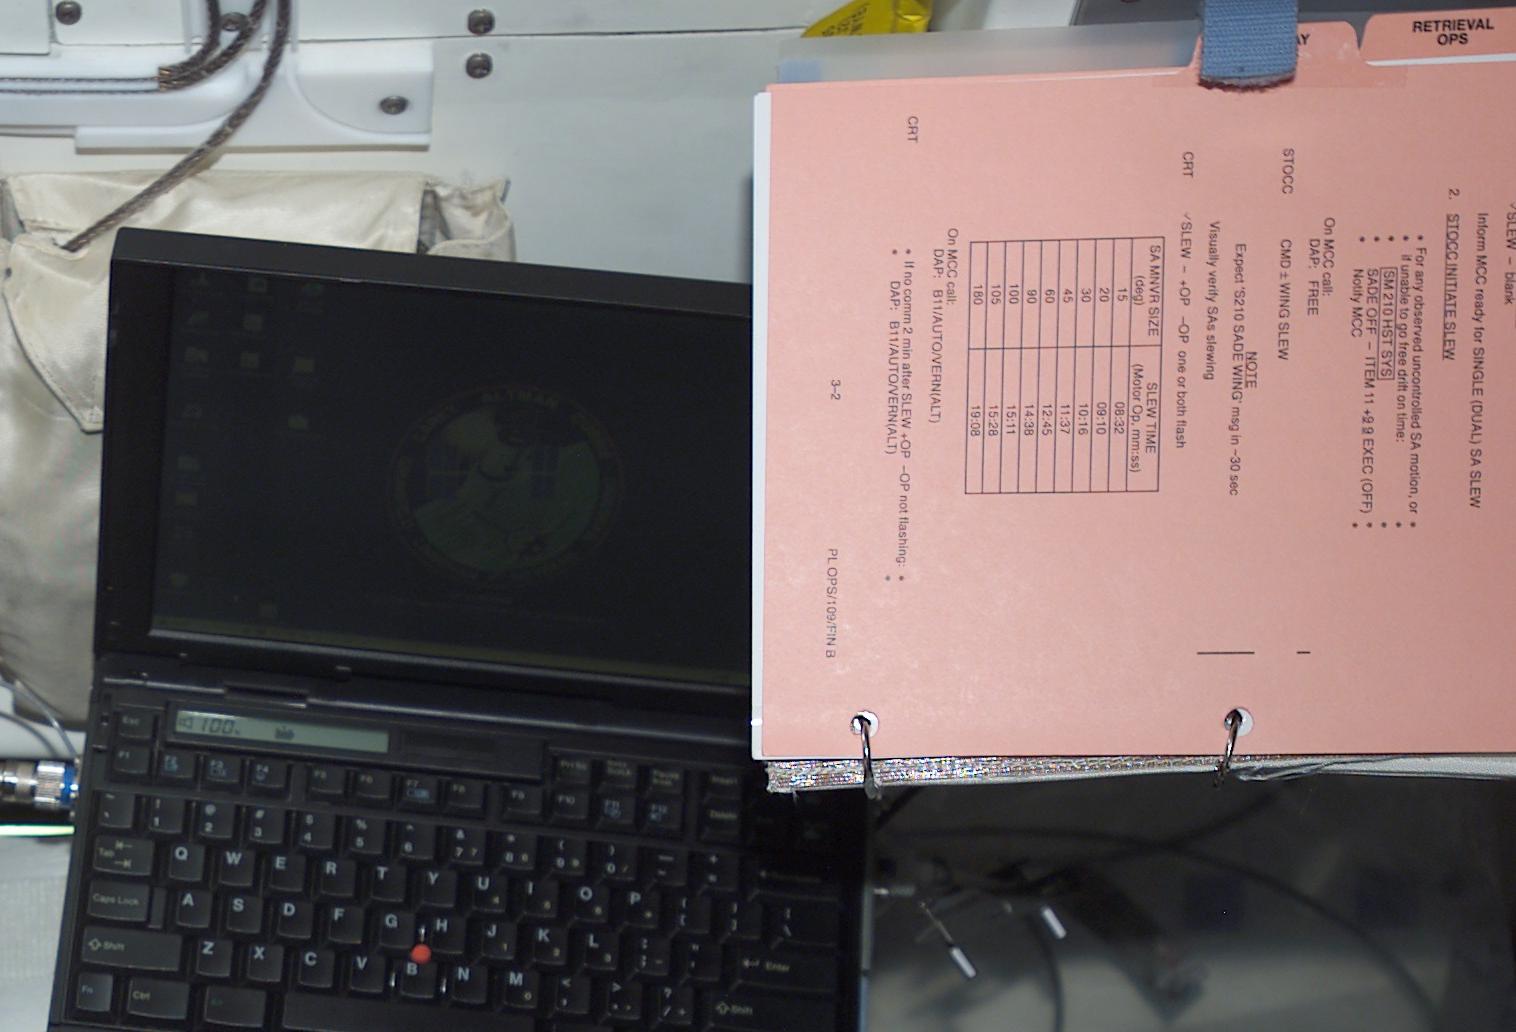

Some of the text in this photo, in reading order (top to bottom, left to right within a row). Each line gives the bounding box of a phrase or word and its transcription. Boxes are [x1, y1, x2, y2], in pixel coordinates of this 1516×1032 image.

[1412, 18, 1495, 33] RETRIEVAL
[1437, 33, 1469, 46] OPS
[906, 115, 919, 144] CRT
[1182, 150, 1195, 179] CRT
[1281, 147, 1296, 195] STOCC
[1180, 221, 1193, 260] SLEW
[1321, 216, 1337, 297] On MCC call:
[903, 260, 916, 269] If
[1232, 243, 1248, 284] Expect
[1503, 211, 1516, 306] SLEW blank
[903, 271, 913, 287] no
[1131, 274, 1146, 306] (deg)
[1147, 244, 1162, 337] SA MNVR SIZE
[1306, 238, 1321, 317] DAP: FREE
[1366, 267, 1381, 304] SADE
[1443, 213, 1461, 361] STOCC INITIATE SLEW
[902, 288, 913, 325] comm
[972, 284, 984, 306] 180
[990, 283, 1002, 306] 105
[1008, 283, 1020, 305] 100
[1026, 288, 1038, 305] 90
[1044, 288, 1056, 304] 60
[1062, 288, 1074, 304] 45
[1080, 288, 1093, 304] 30
[1098, 287, 1111, 303] 20
[1116, 287, 1129, 302] 15
[1202, 220, 1221, 381] Visually verify SAs slewing
[1277, 238, 1293, 361] CMD WING SLEW
[902, 326, 914, 335] 2
[927, 248, 945, 424] DAP: B11/AUTO/VERN(ALT)
[1365, 307, 1378, 335] OFF
[1380, 270, 1396, 377] SM 210 HST SYS
[901, 337, 914, 360] min
[1232, 324, 1246, 362] SADE
[1395, 253, 1413, 443] if unable to go free drift on time:
[901, 362, 913, 390] after
[1176, 350, 1187, 374] one
[1245, 350, 1259, 389] NOTE
[1363, 356, 1377, 389] ITEM
[1468, 212, 1490, 509] Inform MCC ready for SINGLE (DUAL) SA SLEW
[1176, 375, 1187, 389] or
[1407, 246, 1428, 515] For any observed uncontrolled SA motion, or
[900, 392, 914, 429] SLEW
[1176, 390, 1189, 417] both
[1363, 392, 1375, 405] 11
[969, 405, 982, 438] 19:08
[987, 404, 999, 437] 15:28
[1005, 404, 1017, 435] 15:11
[1023, 403, 1035, 437] 14:38
[1041, 403, 1053, 437] 12:45
[1059, 403, 1071, 435] 11:37
[1077, 403, 1090, 436] 10:16
[1095, 401, 1108, 436] 09:10
[1113, 401, 1126, 435] 08:32
[1128, 363, 1145, 474] (Motor Op, mm:ss)
[1144, 382, 1159, 454] SLEW TIME
[1175, 419, 1188, 449] flash
[1227, 406, 1241, 432] msg
[1230, 434, 1242, 446] in
[1361, 437, 1375, 475] EXEC
[1228, 474, 1239, 497] sec
[1359, 478, 1374, 514] (OFF)
[898, 494, 909, 514] not
[827, 548, 839, 564] PL
[895, 516, 910, 567] flashing:
[825, 566, 839, 647] OPS/109/FIN
[93, 892, 140, 907] Caps Lock
[103, 941, 125, 953] Shift
[132, 989, 151, 1001] Ctrl
